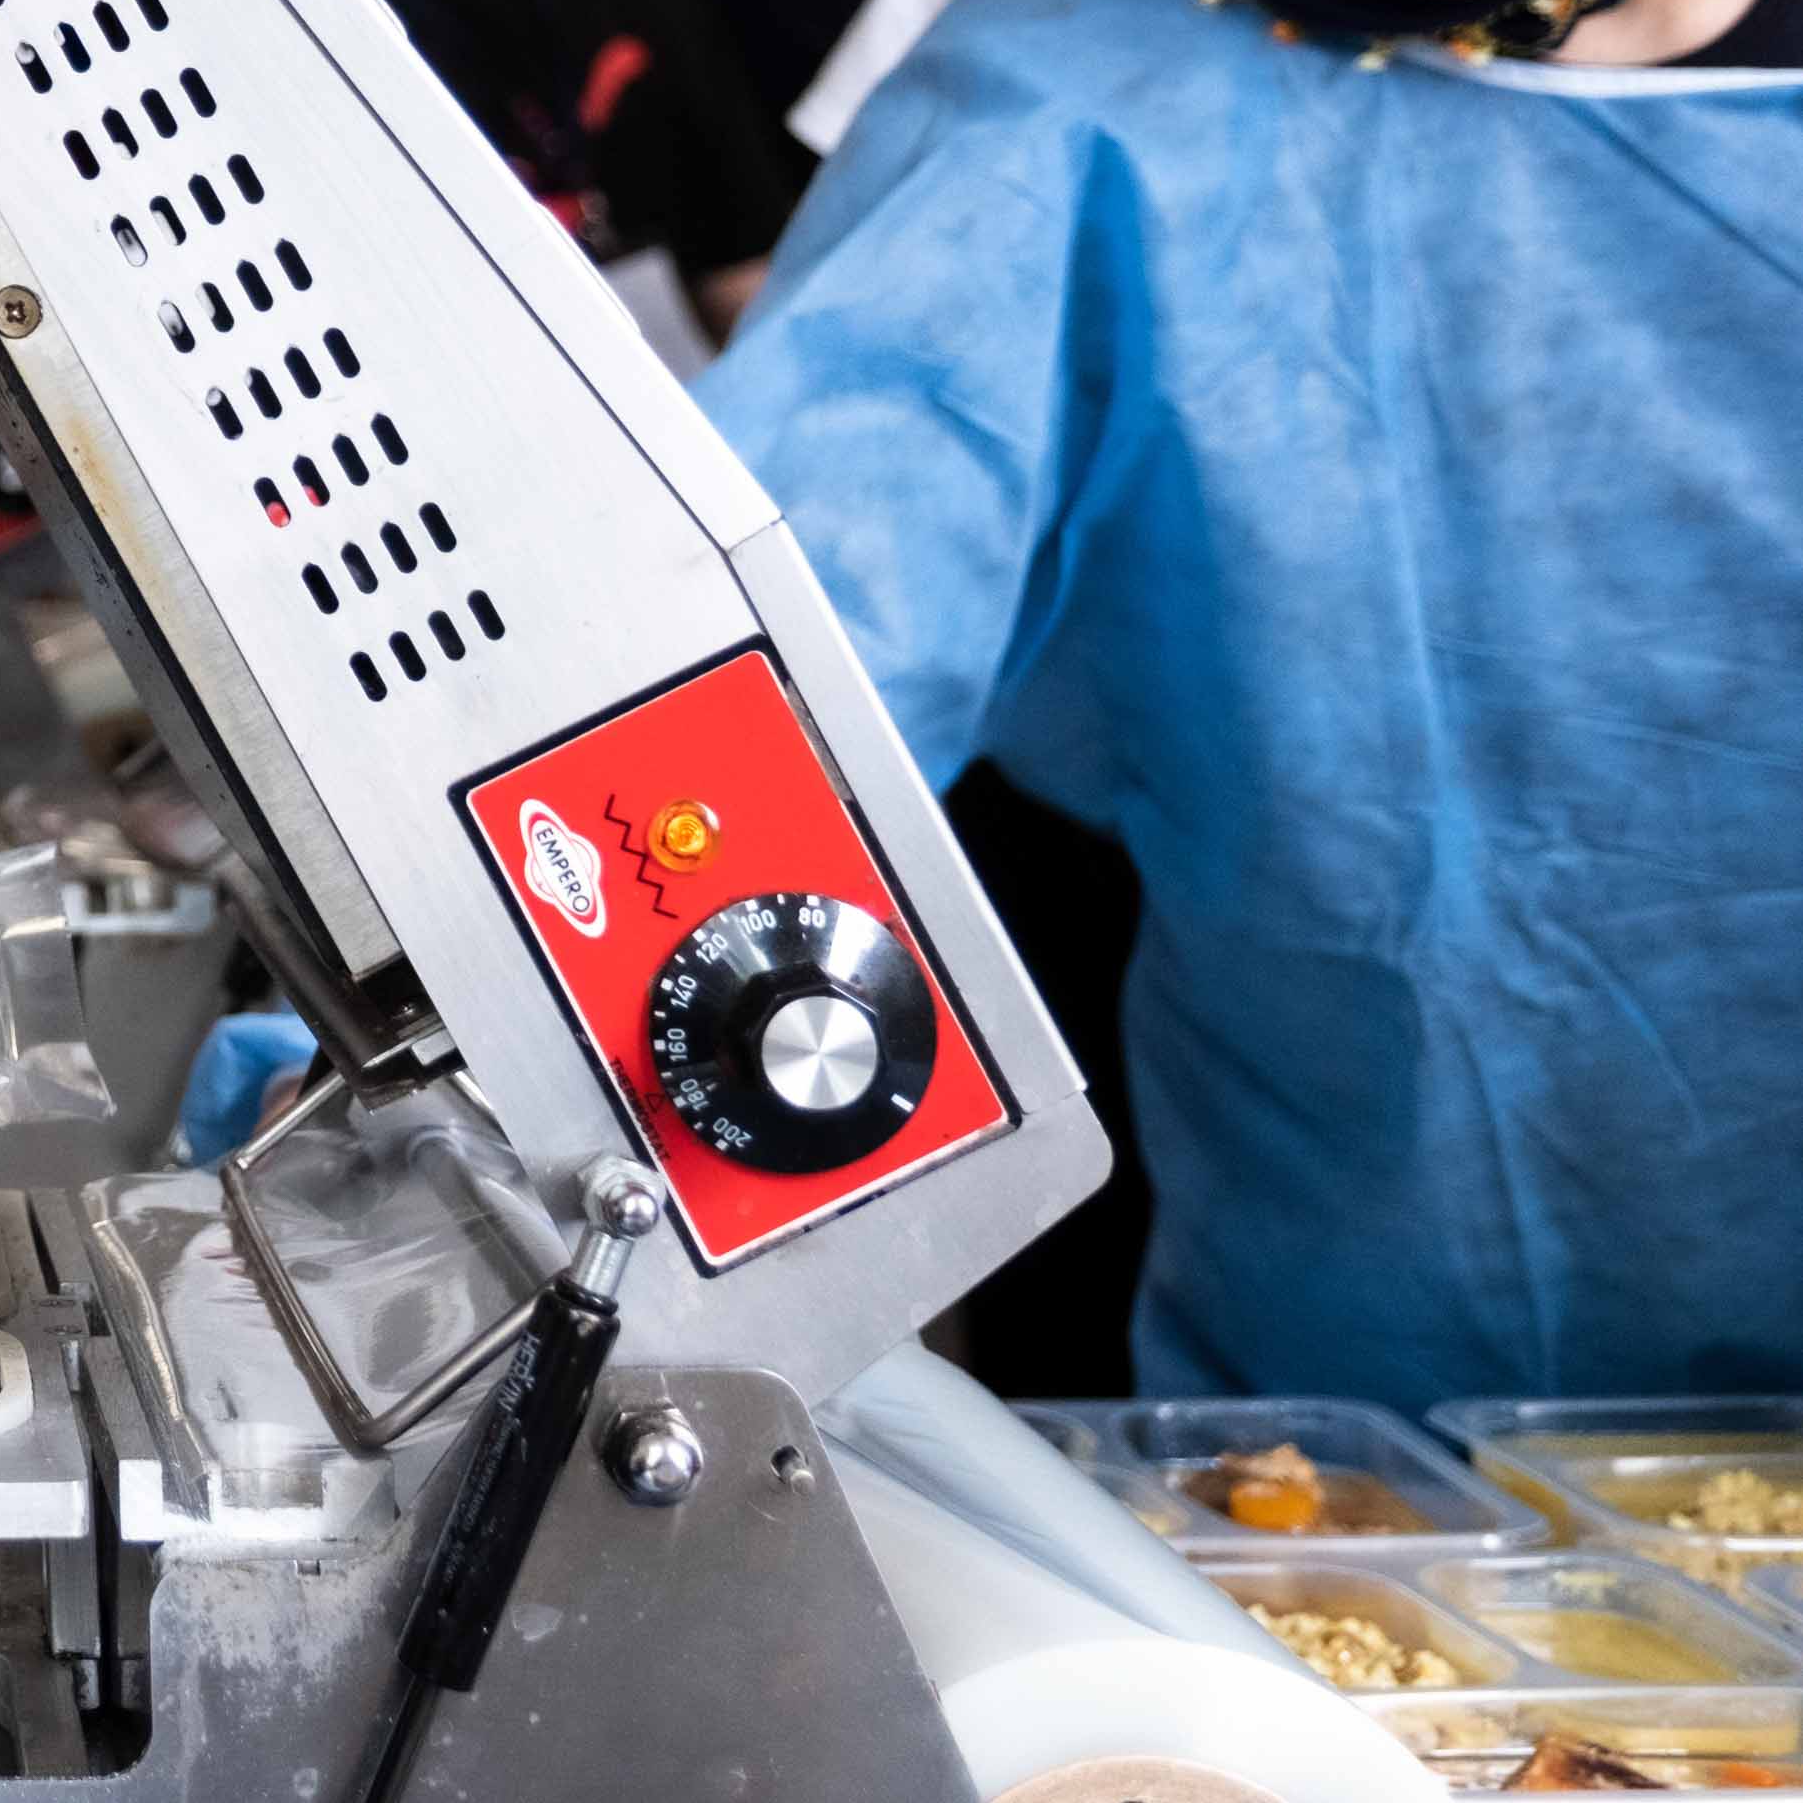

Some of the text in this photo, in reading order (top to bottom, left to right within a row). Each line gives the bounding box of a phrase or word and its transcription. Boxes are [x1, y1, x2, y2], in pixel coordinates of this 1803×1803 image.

[535, 827, 590, 913] EMPERO
[741, 908, 777, 934] 100
[798, 906, 826, 929] 80
[695, 932, 729, 964] 120
[670, 974, 698, 1010] 140
[667, 1027, 688, 1063] 160
[680, 1077, 710, 1111] 180
[712, 1116, 753, 1148] 200
